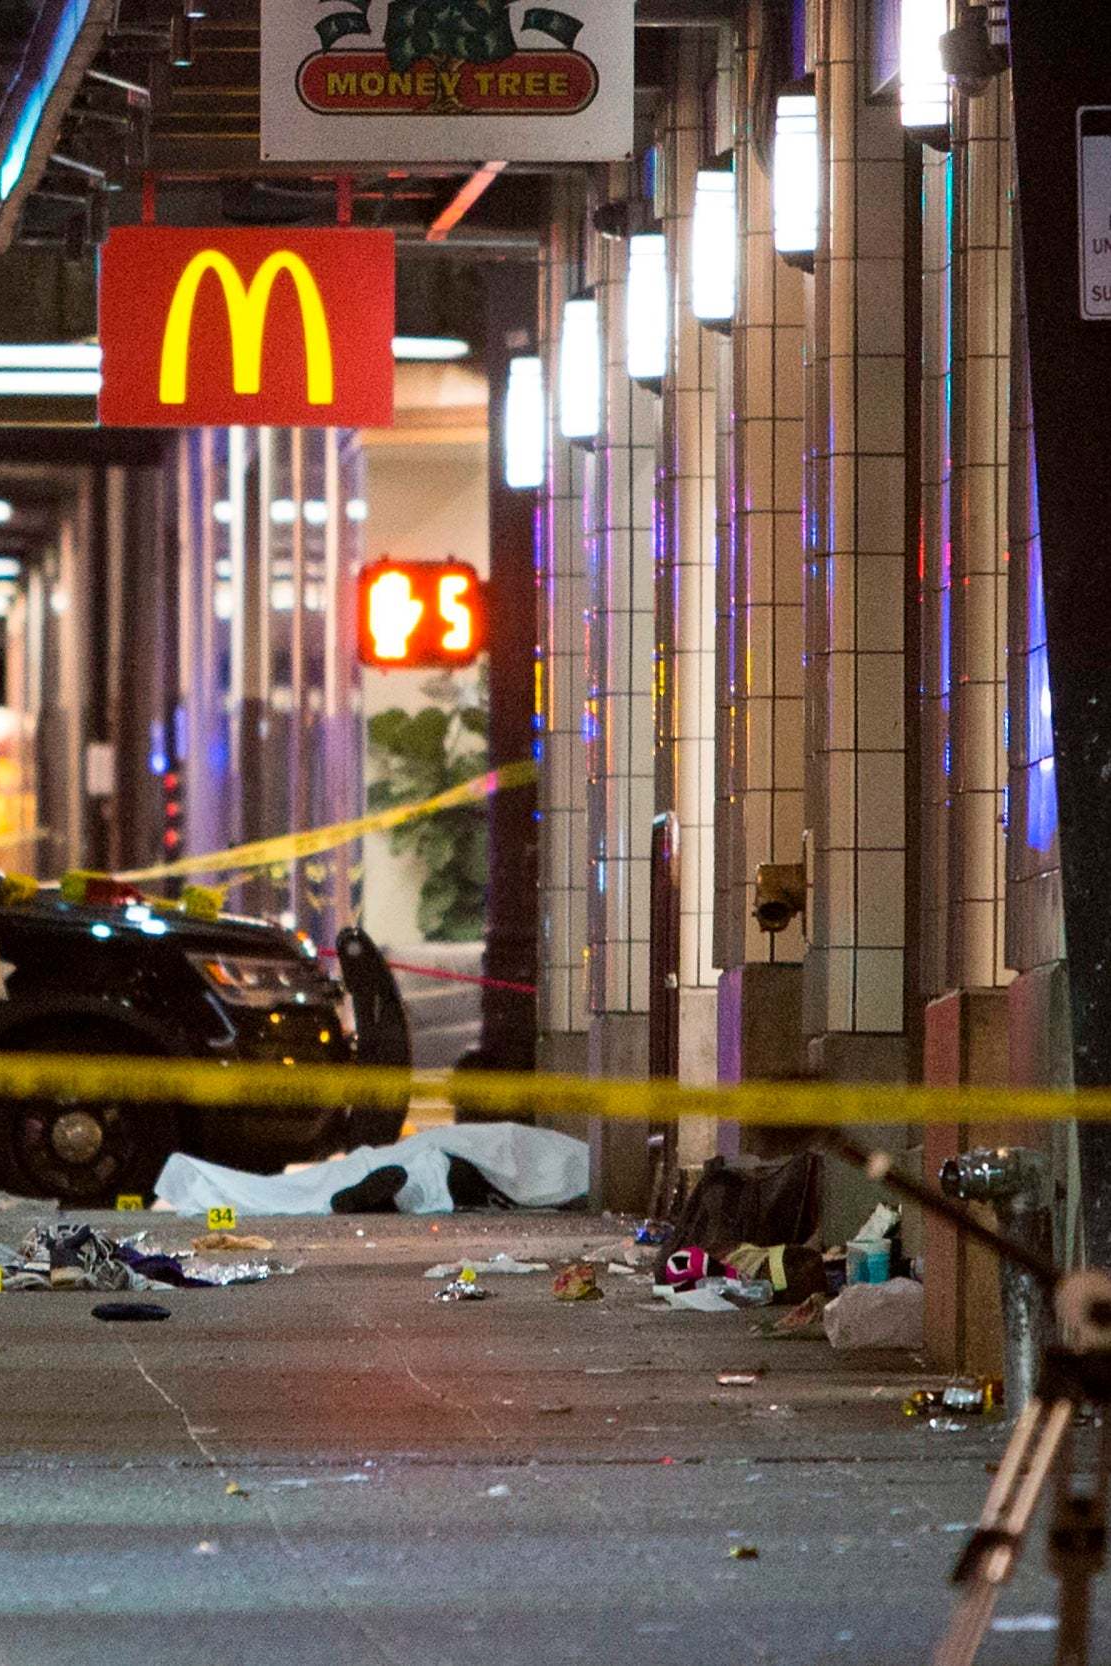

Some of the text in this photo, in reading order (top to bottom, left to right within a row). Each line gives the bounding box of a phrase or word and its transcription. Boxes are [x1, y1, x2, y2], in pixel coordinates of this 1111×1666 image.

[325, 71, 570, 97] MONEY TREE
[438, 572, 471, 651] 5
[210, 1208, 233, 1223] 34
